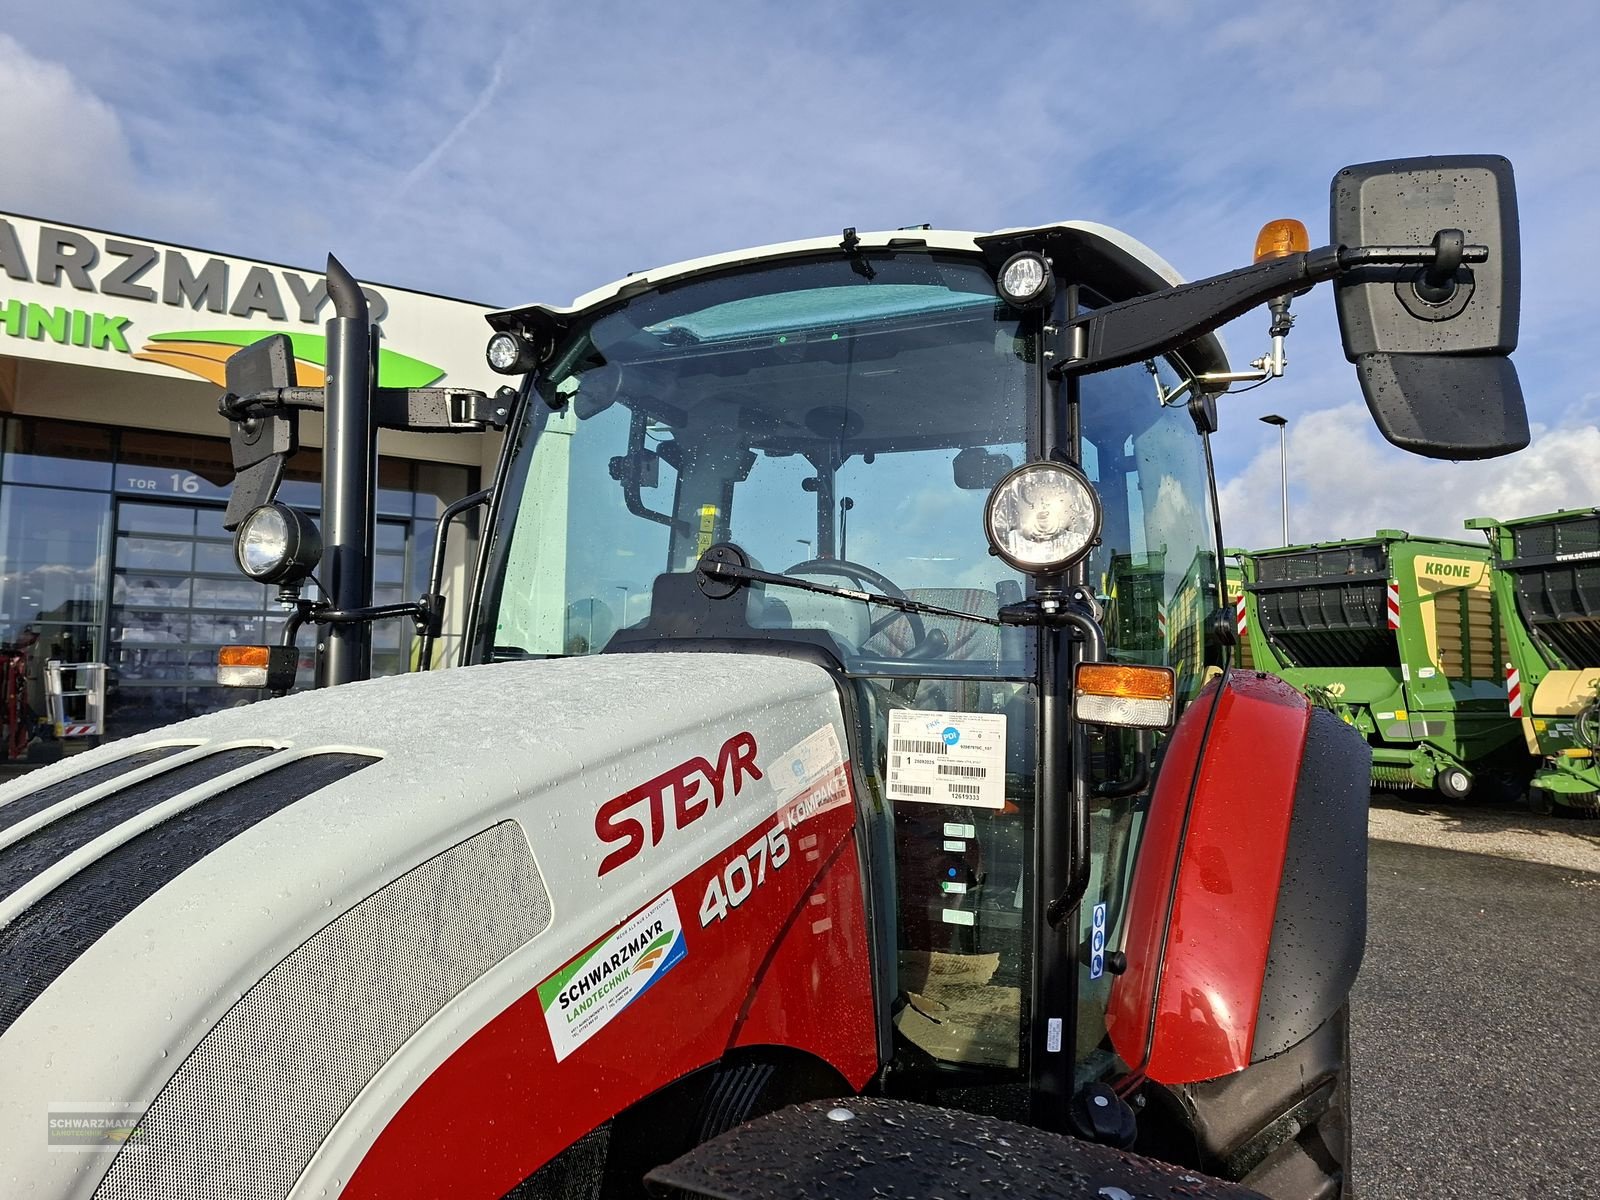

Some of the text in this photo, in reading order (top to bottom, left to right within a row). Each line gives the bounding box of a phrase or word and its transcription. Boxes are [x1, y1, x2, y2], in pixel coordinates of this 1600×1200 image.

[128, 473, 199, 493] TOR 16
[1425, 562, 1471, 578] KRONE
[906, 756, 911, 764] 1
[594, 731, 763, 878] STEYR
[951, 793, 980, 801] 12619333
[699, 824, 791, 929] 4075
[557, 918, 664, 1011] SCHWARZMAYR
[565, 965, 631, 1025] LANDTECHNIK
